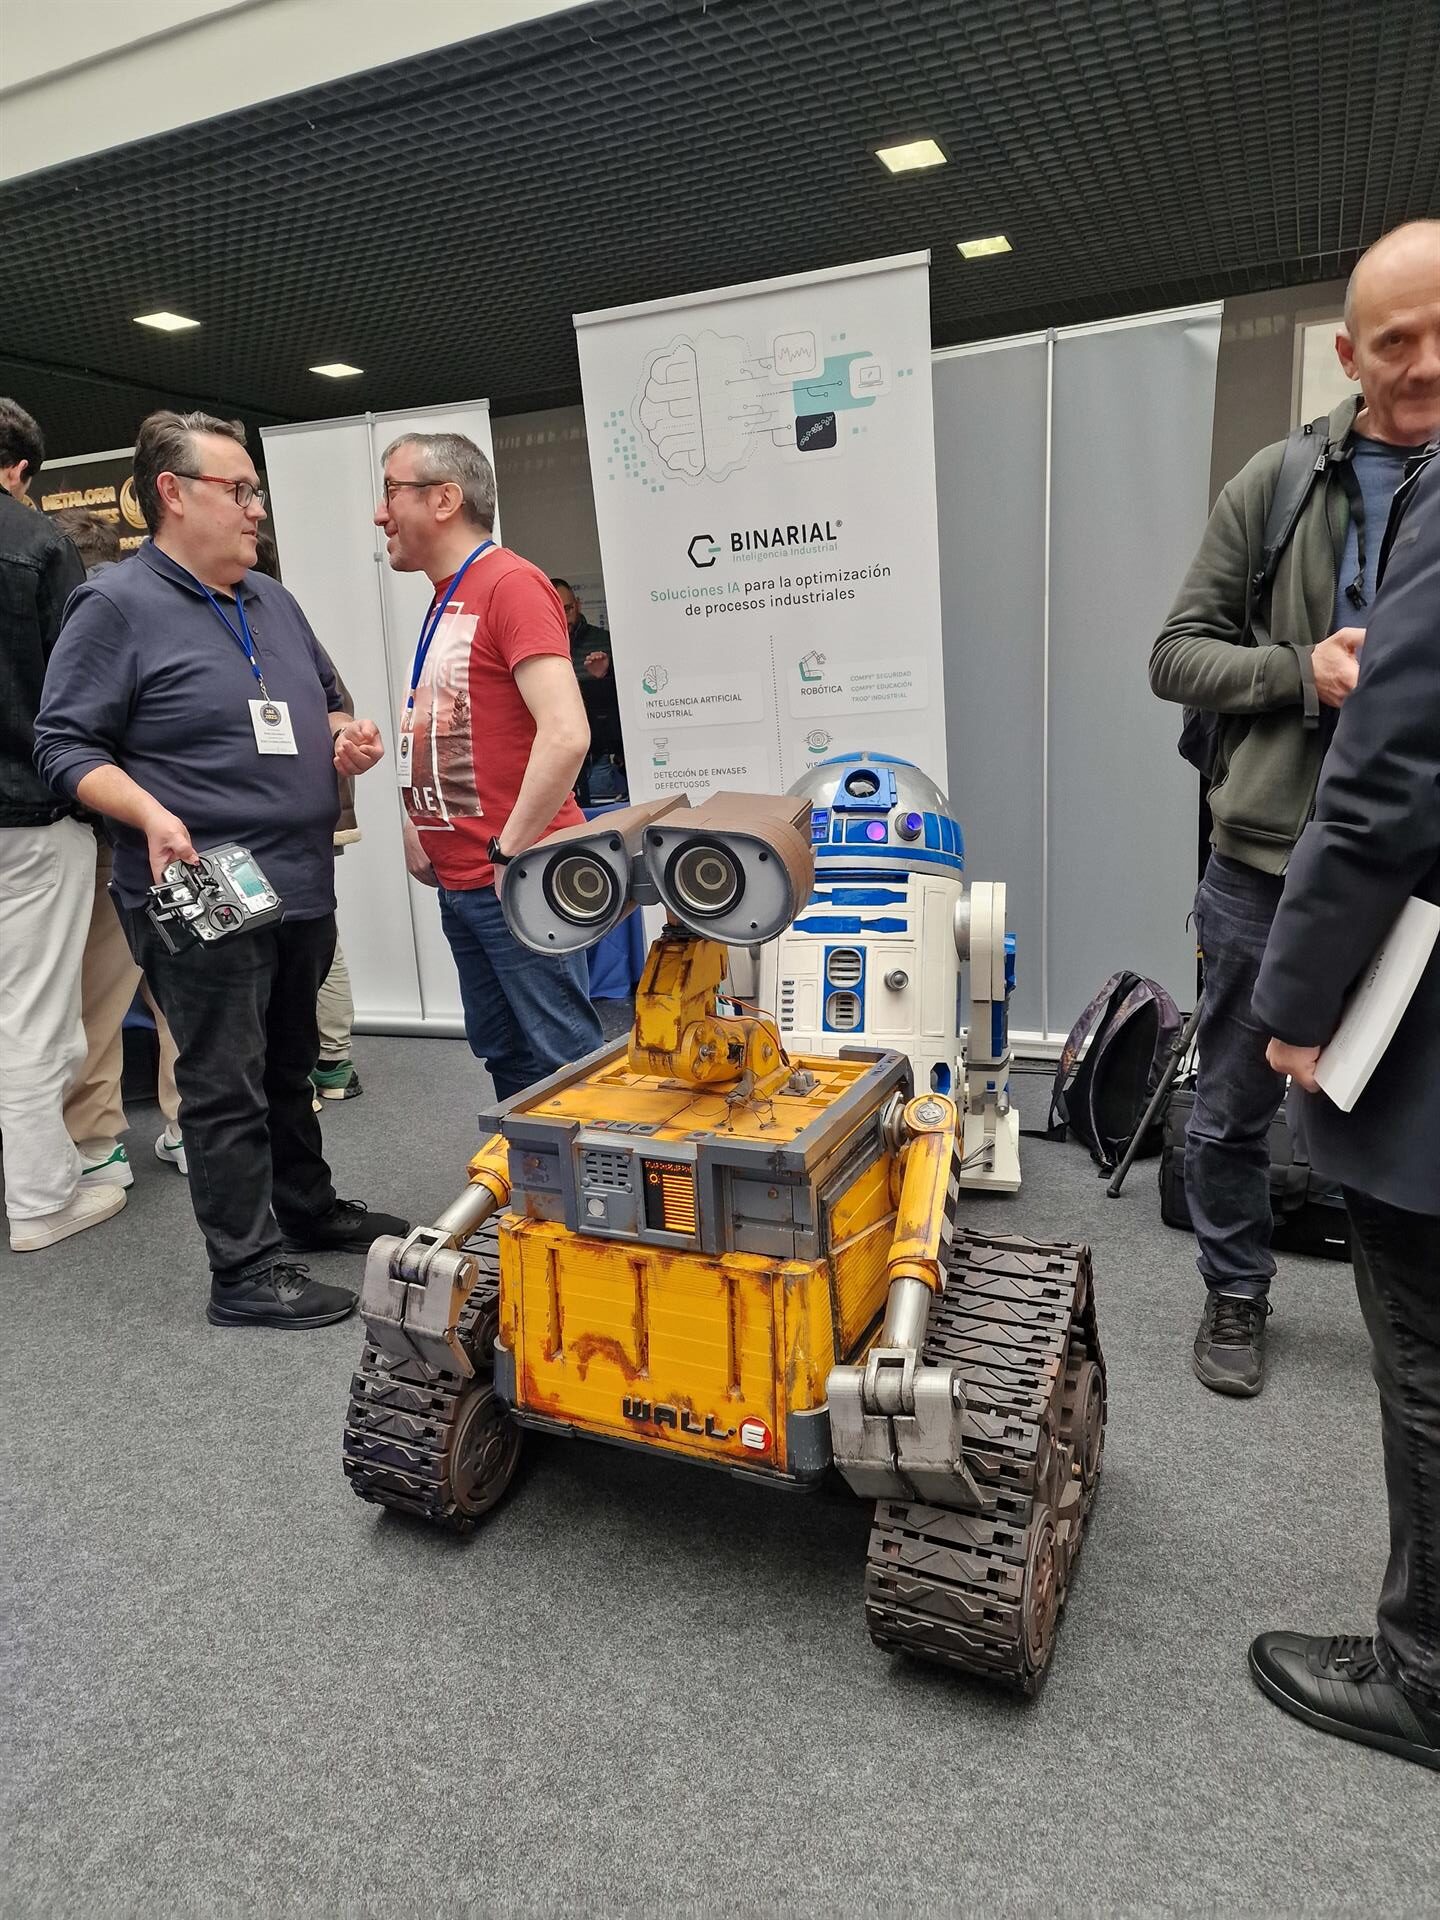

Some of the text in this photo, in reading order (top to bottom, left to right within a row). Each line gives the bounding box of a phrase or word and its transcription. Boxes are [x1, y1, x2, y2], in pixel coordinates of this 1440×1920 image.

[732, 542, 838, 563] Inteligencia Industrial
[650, 563, 891, 602] Soluciones IA para la optimización
[685, 588, 855, 617] de procesos industriales
[800, 684, 843, 696] ROBÓTICA
[645, 693, 742, 708] INTELIGENCIA ARTIFICIAL
[647, 709, 693, 719] INDUSTRIAL
[653, 766, 748, 779] DETECCIÓN DE ENVASES
[655, 780, 710, 790] DEFECTUOSOS
